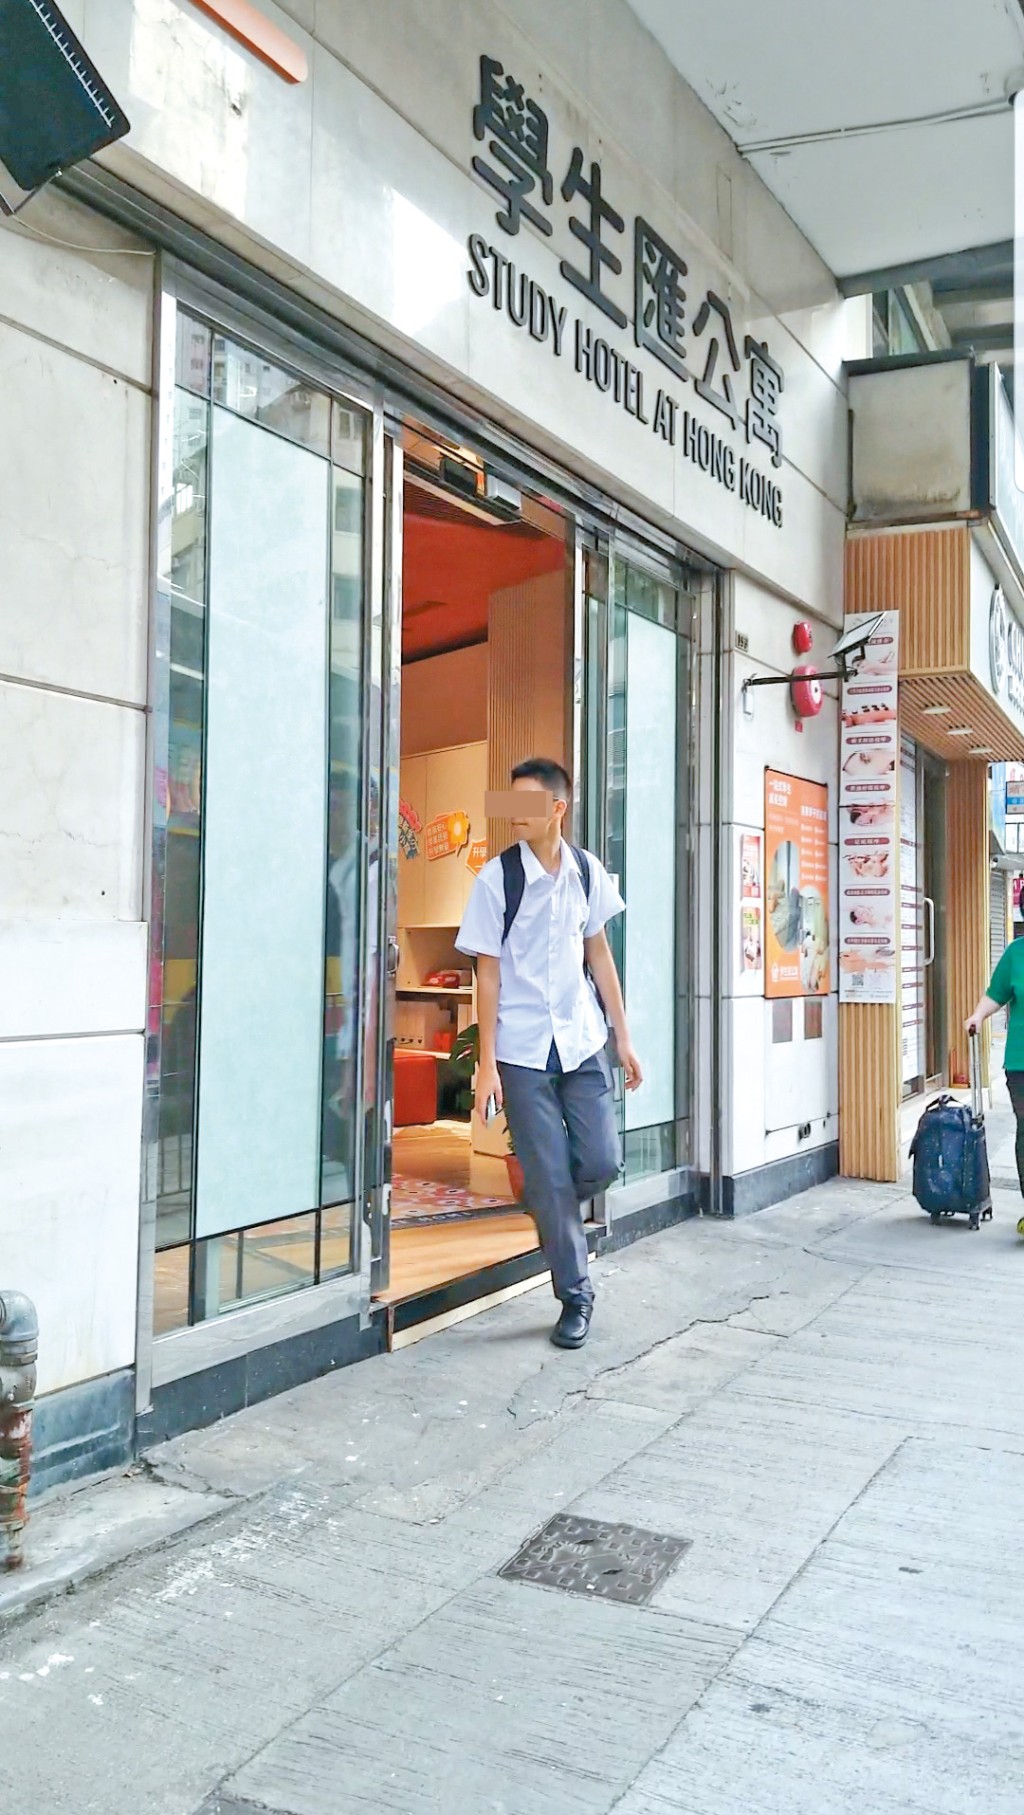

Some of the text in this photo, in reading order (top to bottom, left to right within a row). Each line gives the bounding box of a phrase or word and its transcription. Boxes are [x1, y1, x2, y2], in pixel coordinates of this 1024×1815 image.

[467, 233, 783, 528] STUDY HOTEL AT HONG KONG
[473, 54, 784, 468] 學生匯公寓
